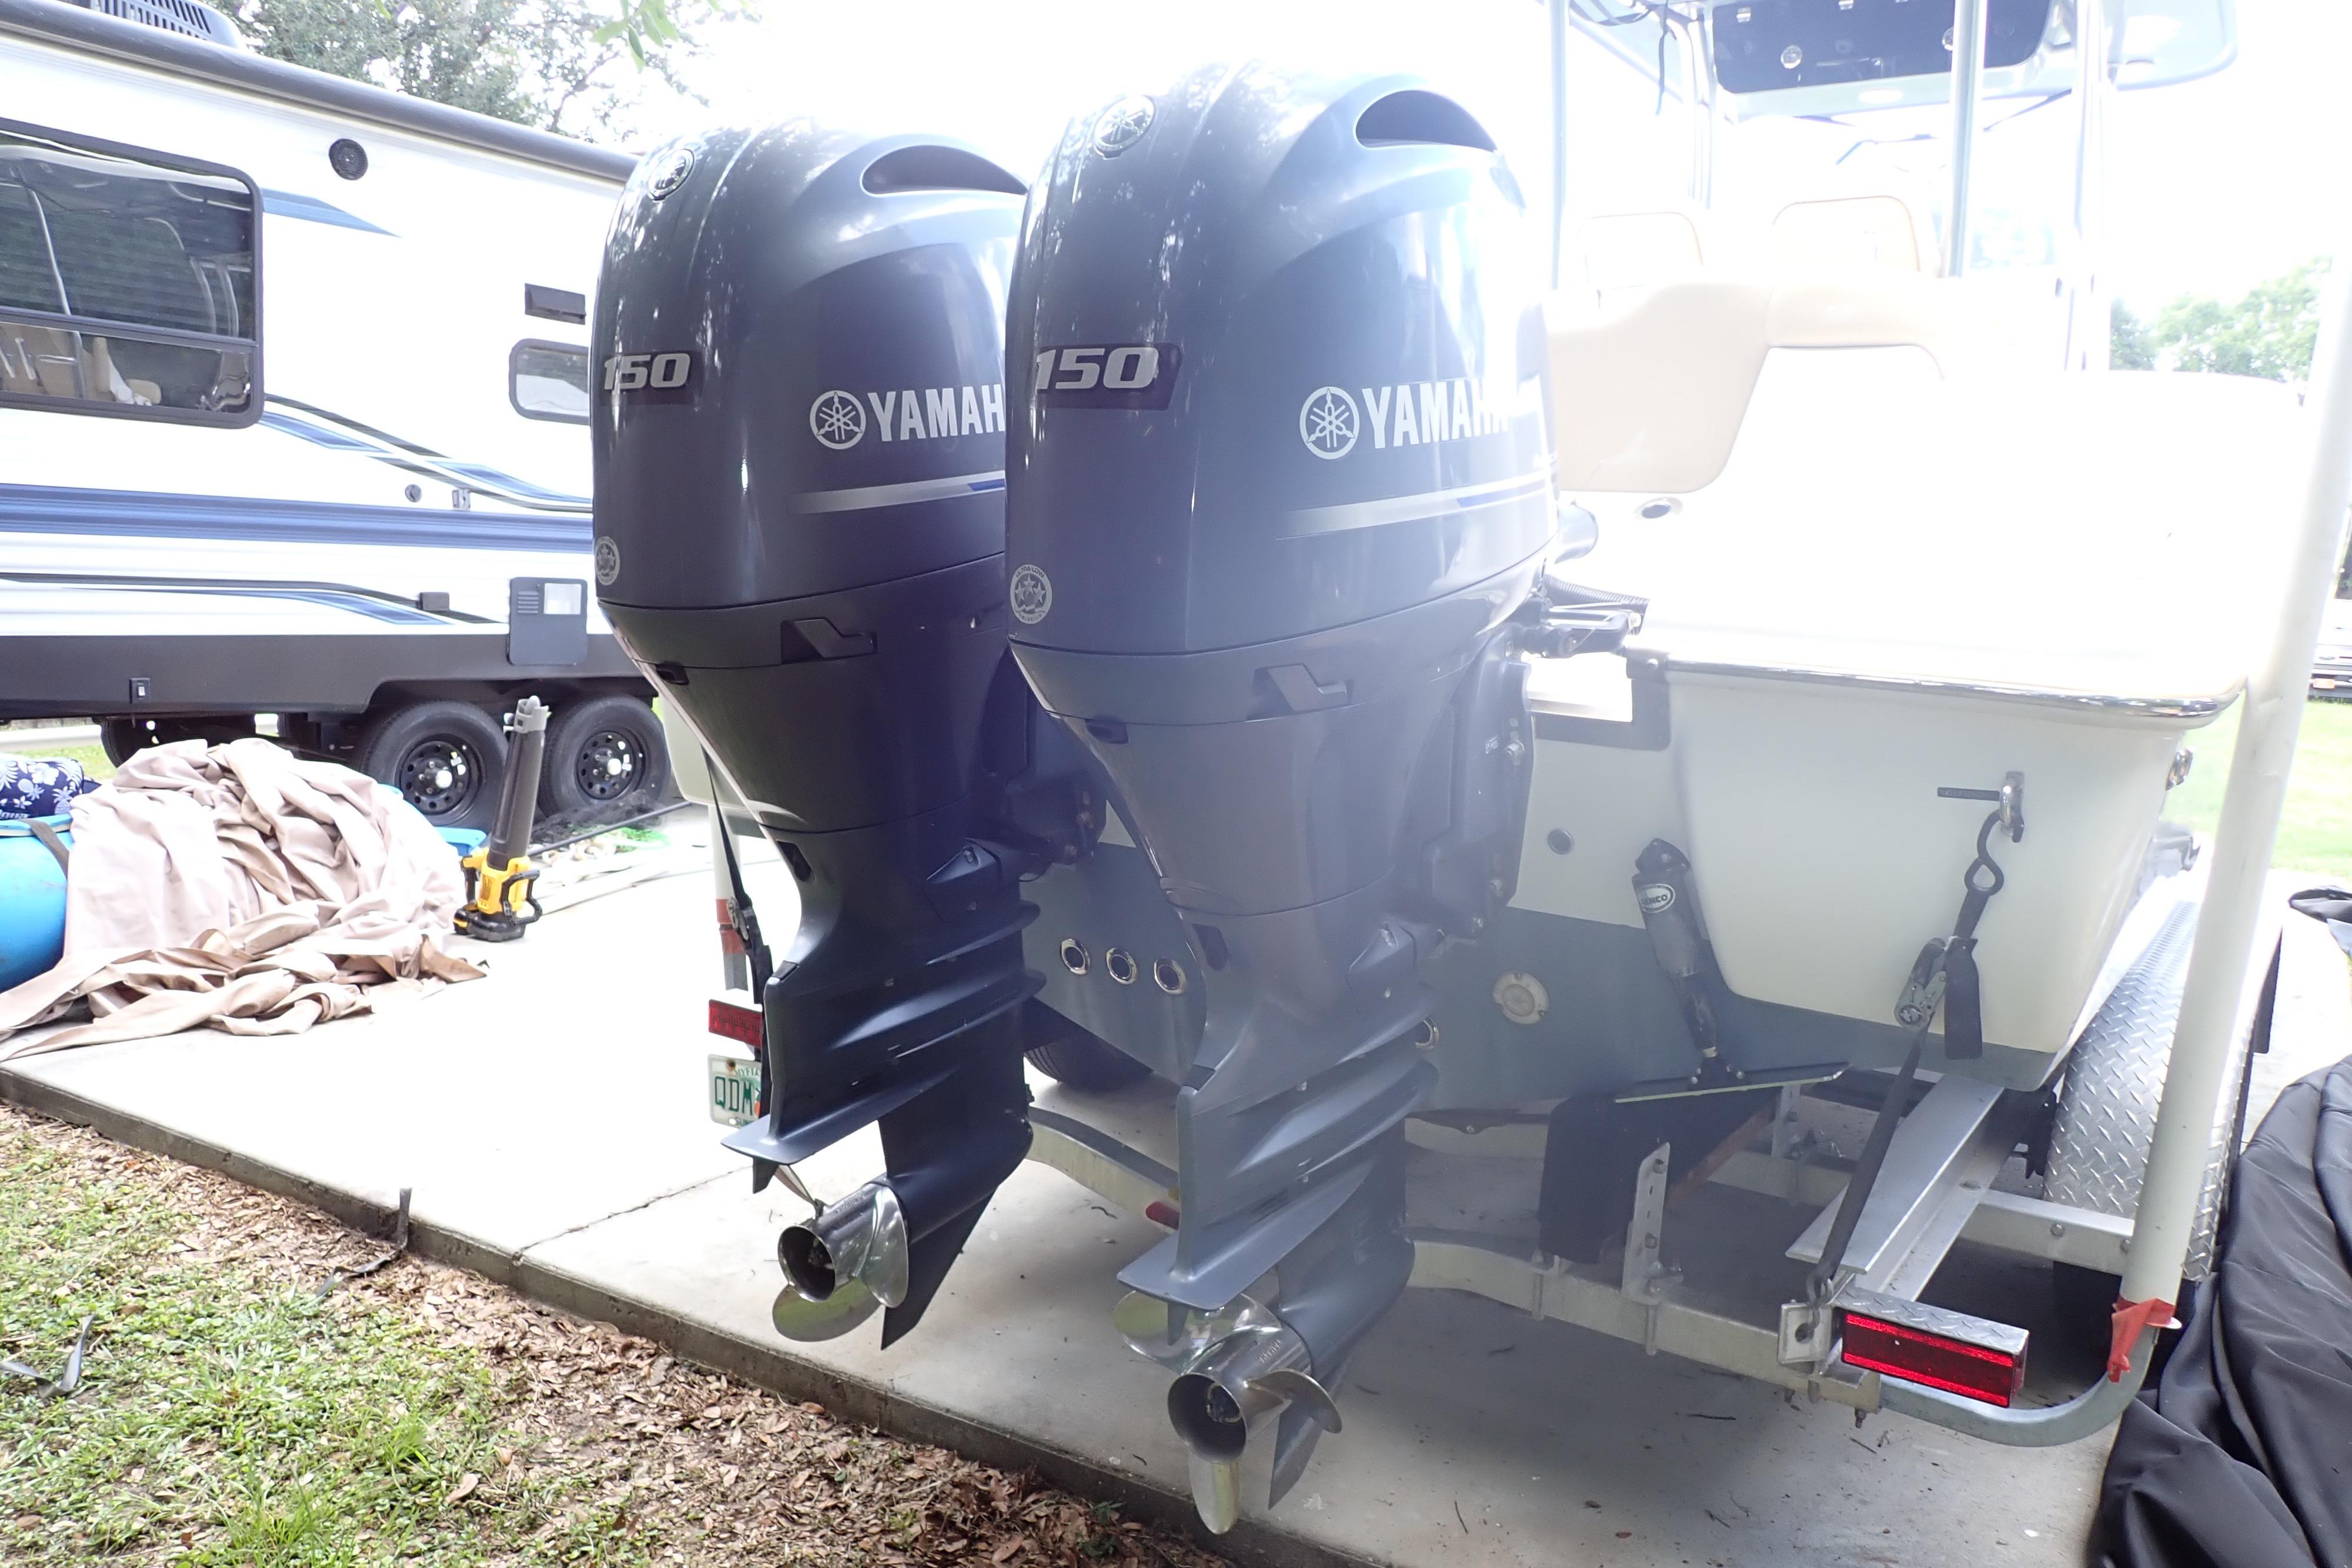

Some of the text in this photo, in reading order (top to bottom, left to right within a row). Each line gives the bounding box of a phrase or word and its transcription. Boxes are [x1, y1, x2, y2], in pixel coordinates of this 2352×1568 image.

[604, 353, 690, 390] 150
[1035, 347, 1160, 390] 150
[1031, 566, 1045, 578] LOW
[714, 1076, 753, 1116] QDM
